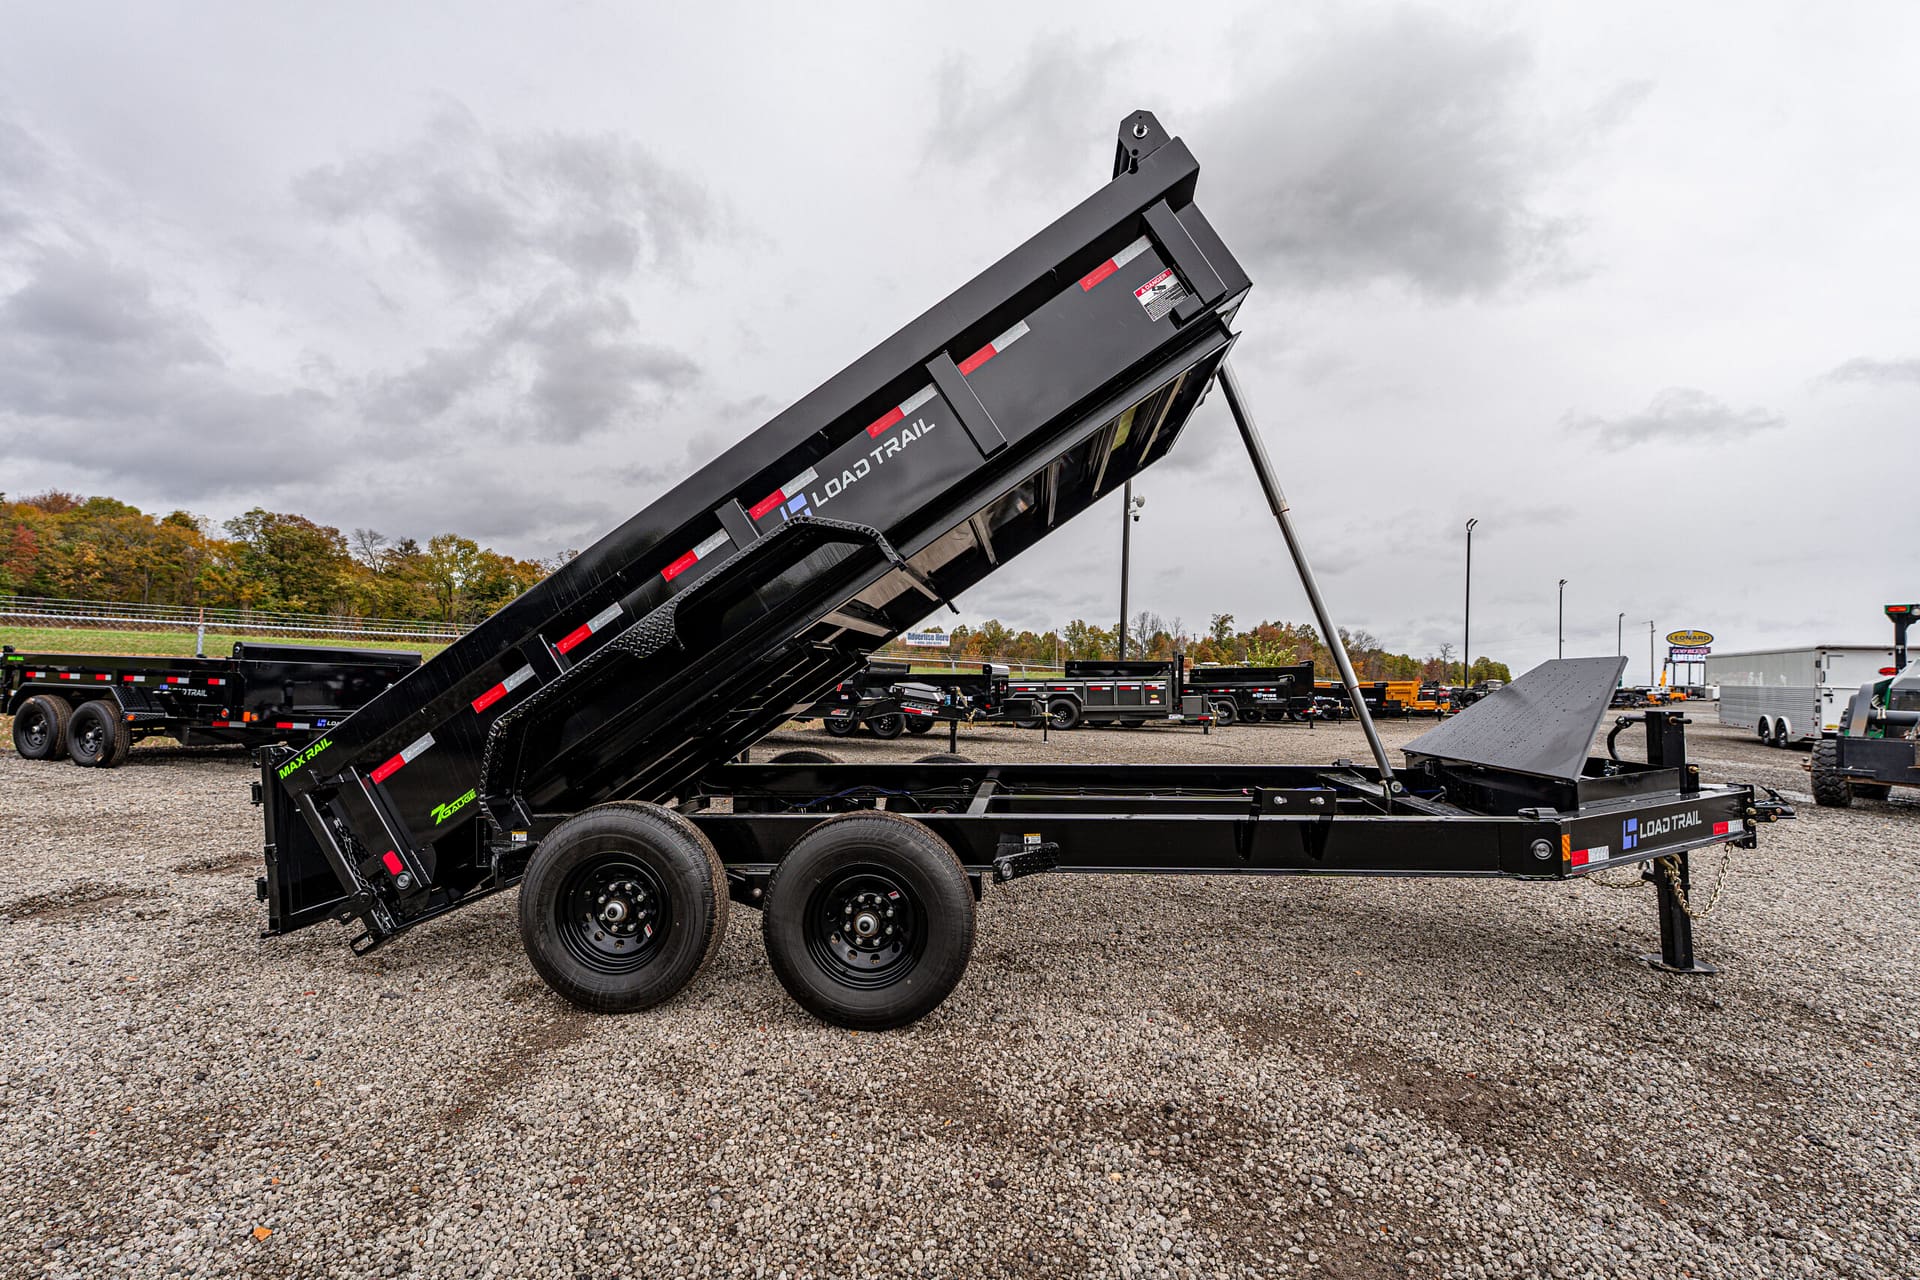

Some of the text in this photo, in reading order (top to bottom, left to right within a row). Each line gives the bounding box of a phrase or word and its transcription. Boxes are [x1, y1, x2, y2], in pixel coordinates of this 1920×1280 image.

[811, 418, 936, 508] LOAD TRAIL
[907, 633, 935, 641] Advertise
[187, 688, 208, 697] TRAIL
[278, 738, 333, 780] MAX RAIL
[1640, 810, 1702, 839] LOAD TRAIL
